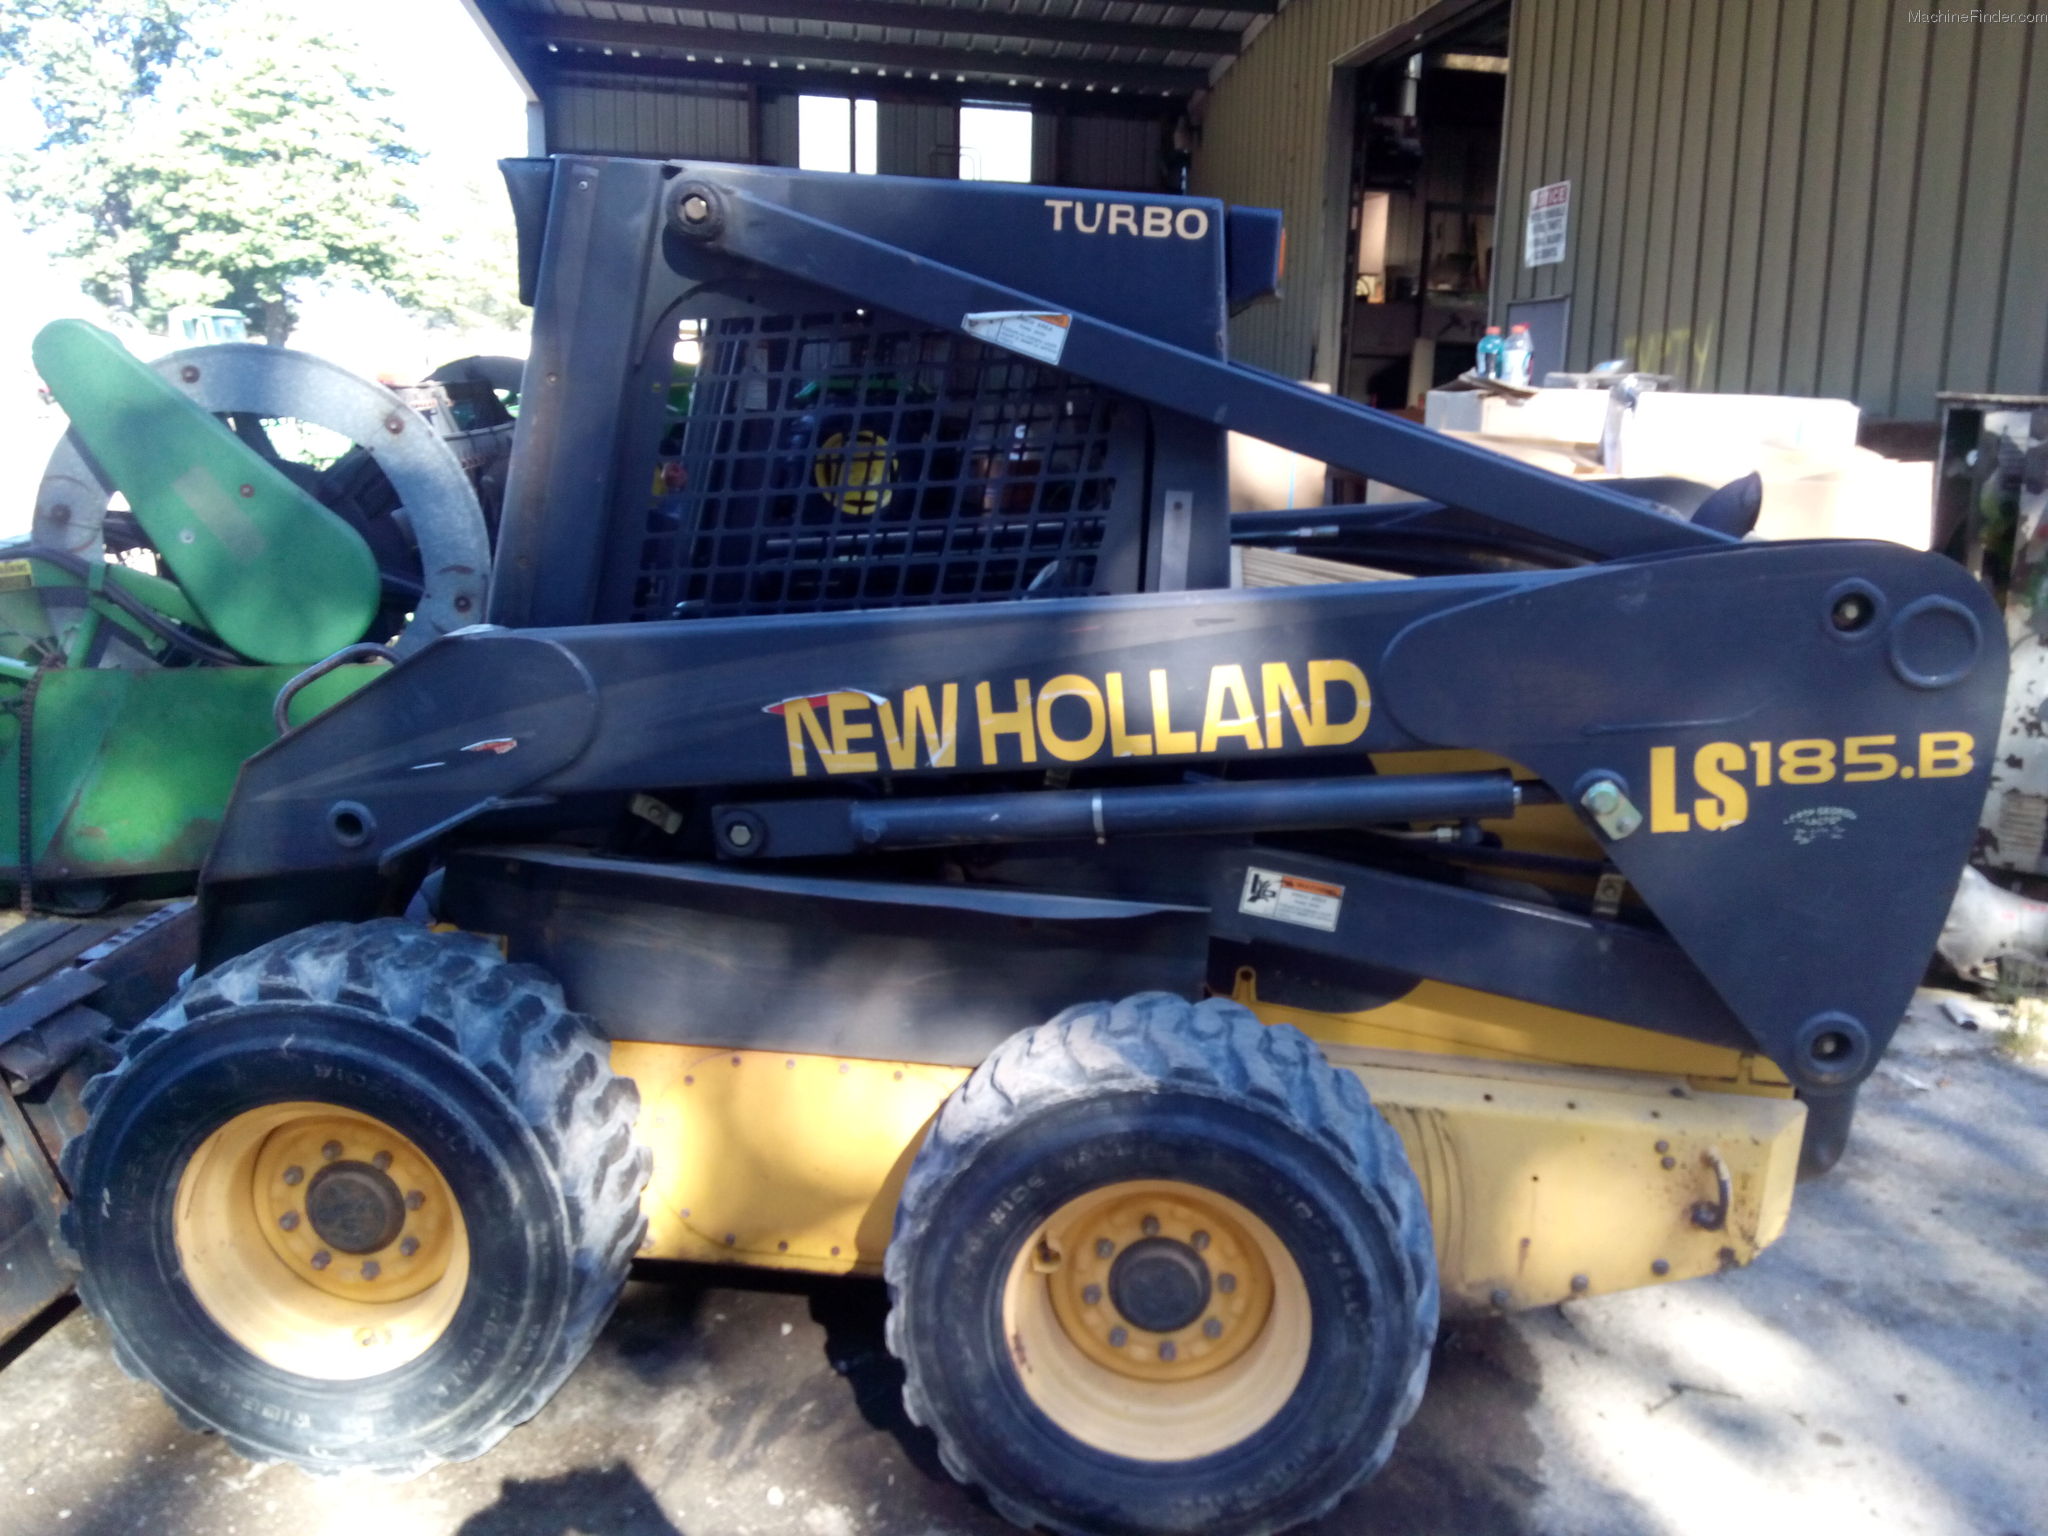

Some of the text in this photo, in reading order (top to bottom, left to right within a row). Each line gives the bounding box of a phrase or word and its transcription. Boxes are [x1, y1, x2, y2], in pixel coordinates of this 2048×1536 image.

[1045, 199, 1209, 240] TURBO
[783, 659, 1372, 777] NEW HOLLAND
